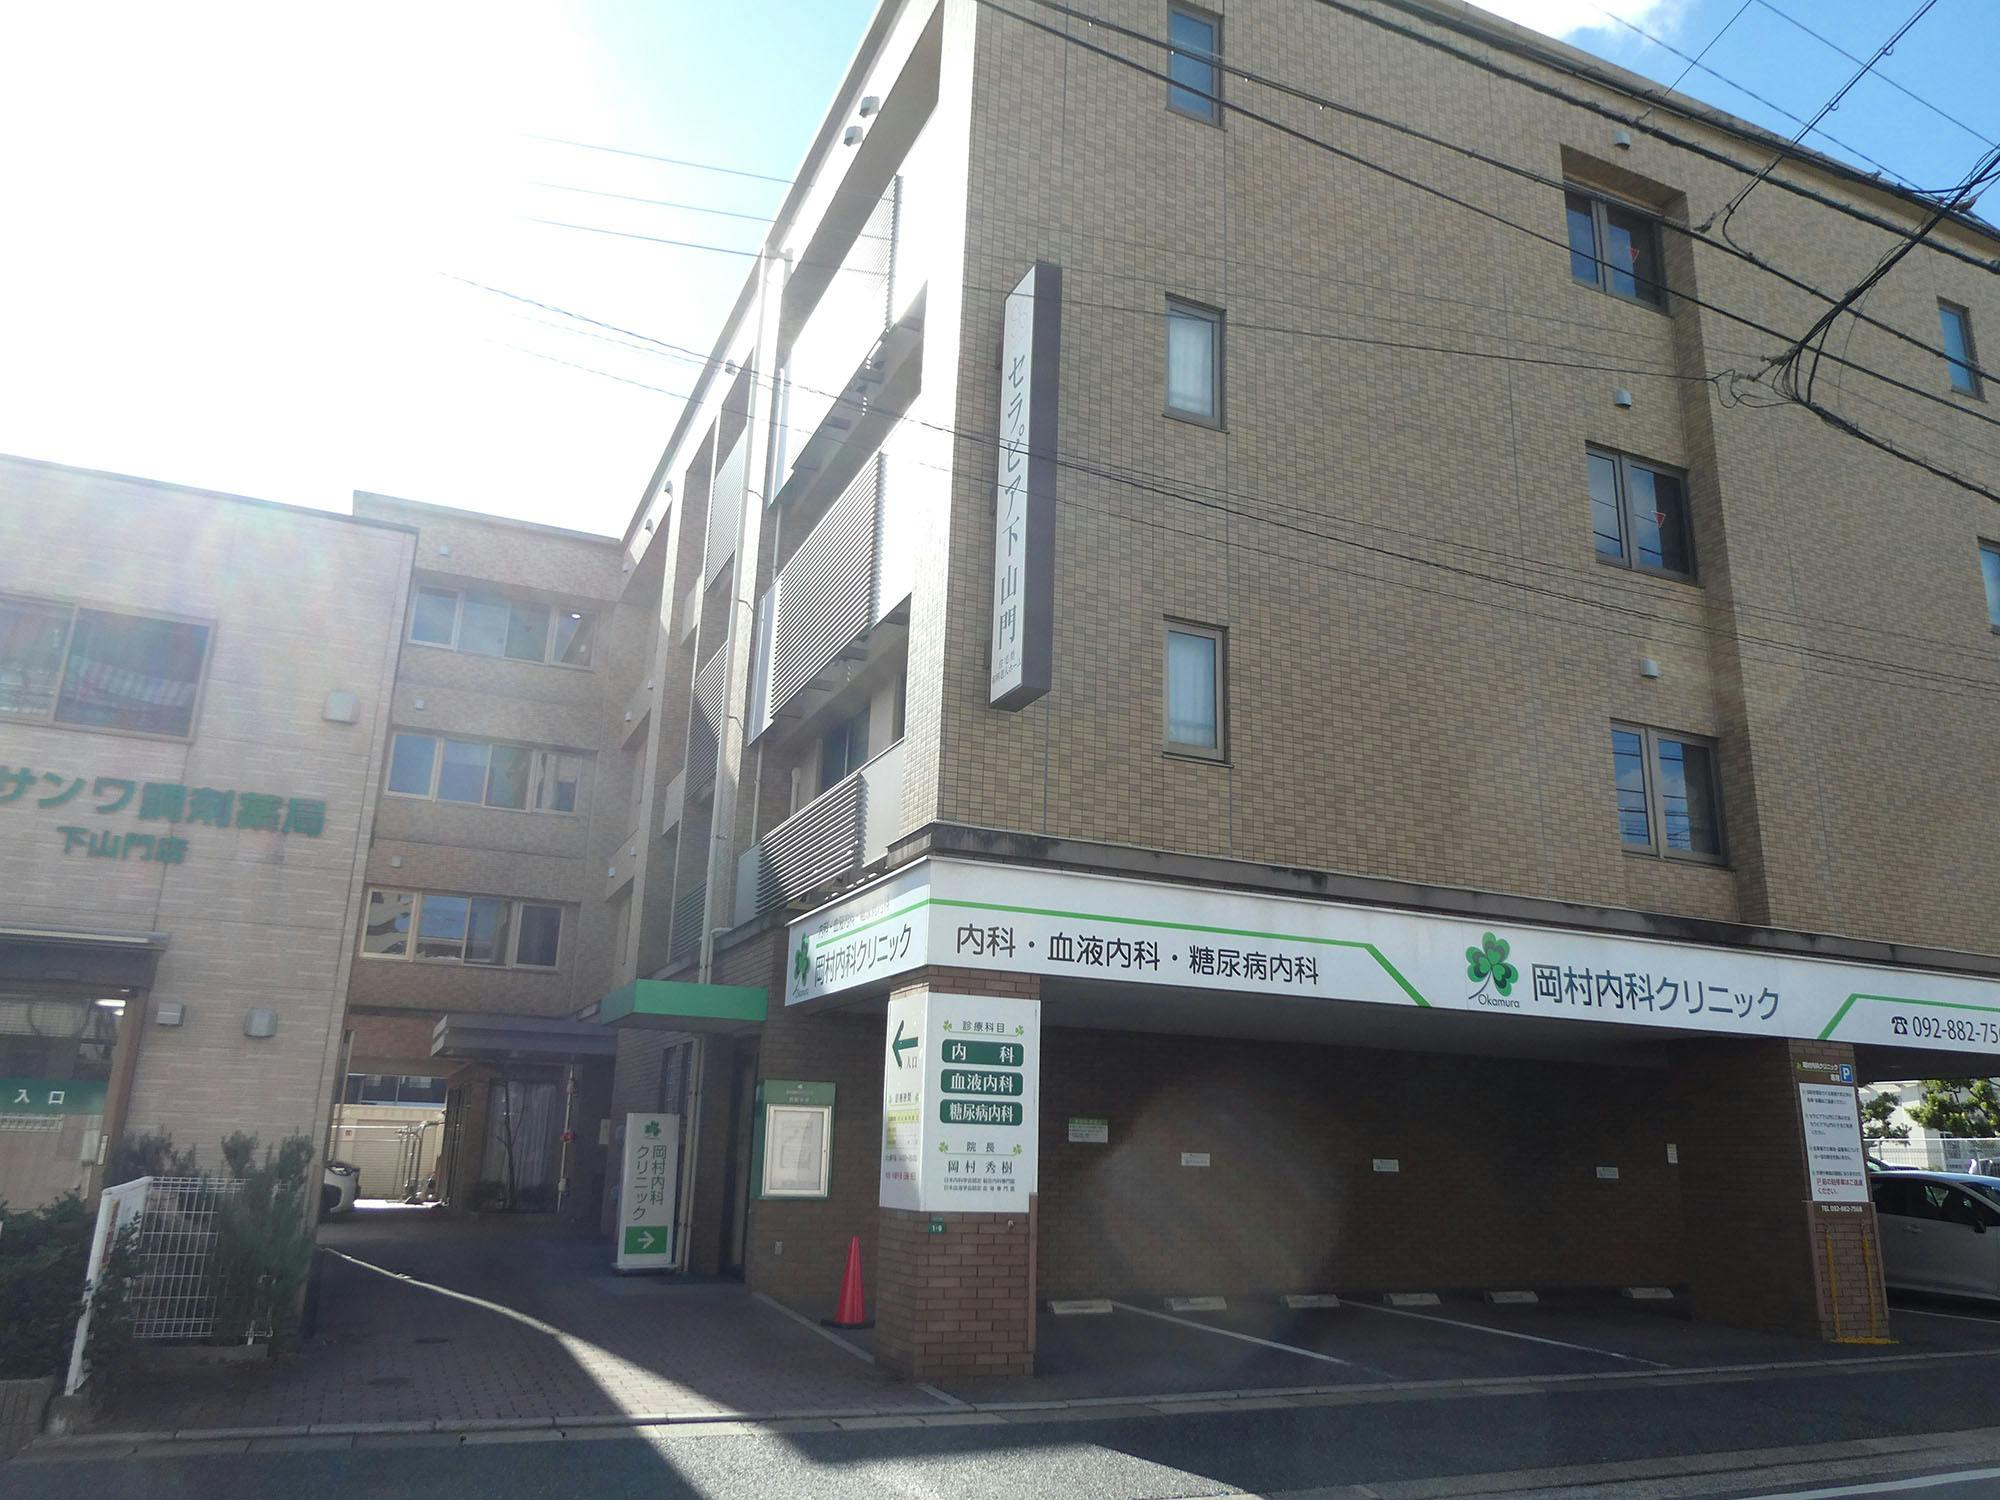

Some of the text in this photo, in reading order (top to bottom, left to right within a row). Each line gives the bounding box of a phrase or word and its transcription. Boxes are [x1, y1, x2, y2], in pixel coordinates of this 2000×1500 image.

[57, 826, 189, 864] 下山門店
[814, 924, 912, 987] 岡村内科クリニック
[1478, 994, 1521, 1008] Okamura
[1531, 962, 1780, 1020] 岡村内科クリニック
[962, 1021, 1005, 1033] 診療科目
[1913, 1016, 2000, 1044] 092-882-75
[950, 1073, 1013, 1093] 血液内科
[949, 1102, 1014, 1123] 糖尿病内科
[633, 1145, 650, 1221] クリニック
[649, 1144, 667, 1205] 岡村内科
